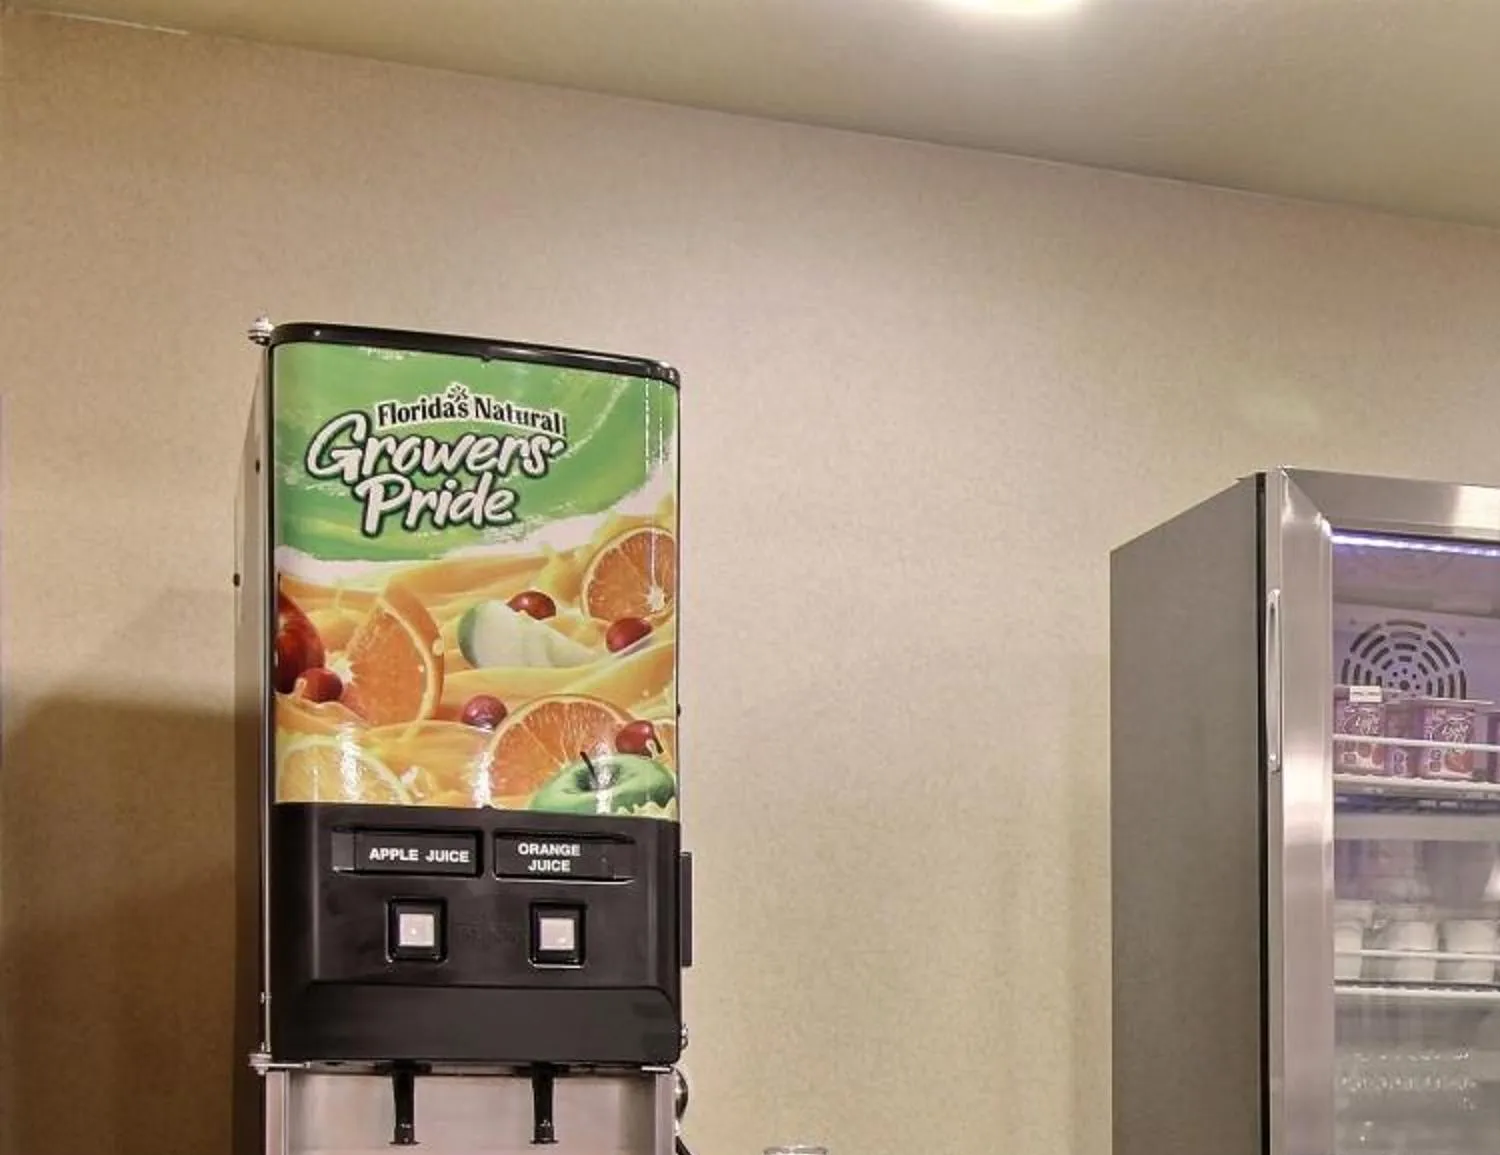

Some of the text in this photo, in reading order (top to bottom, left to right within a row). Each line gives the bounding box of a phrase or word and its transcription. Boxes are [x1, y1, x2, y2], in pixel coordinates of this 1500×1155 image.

[474, 398, 562, 435] Natural
[353, 471, 519, 537] Pride
[368, 847, 471, 864] APPLE JUICE
[517, 842, 581, 857] ORANGE
[528, 858, 572, 872] JUICE
